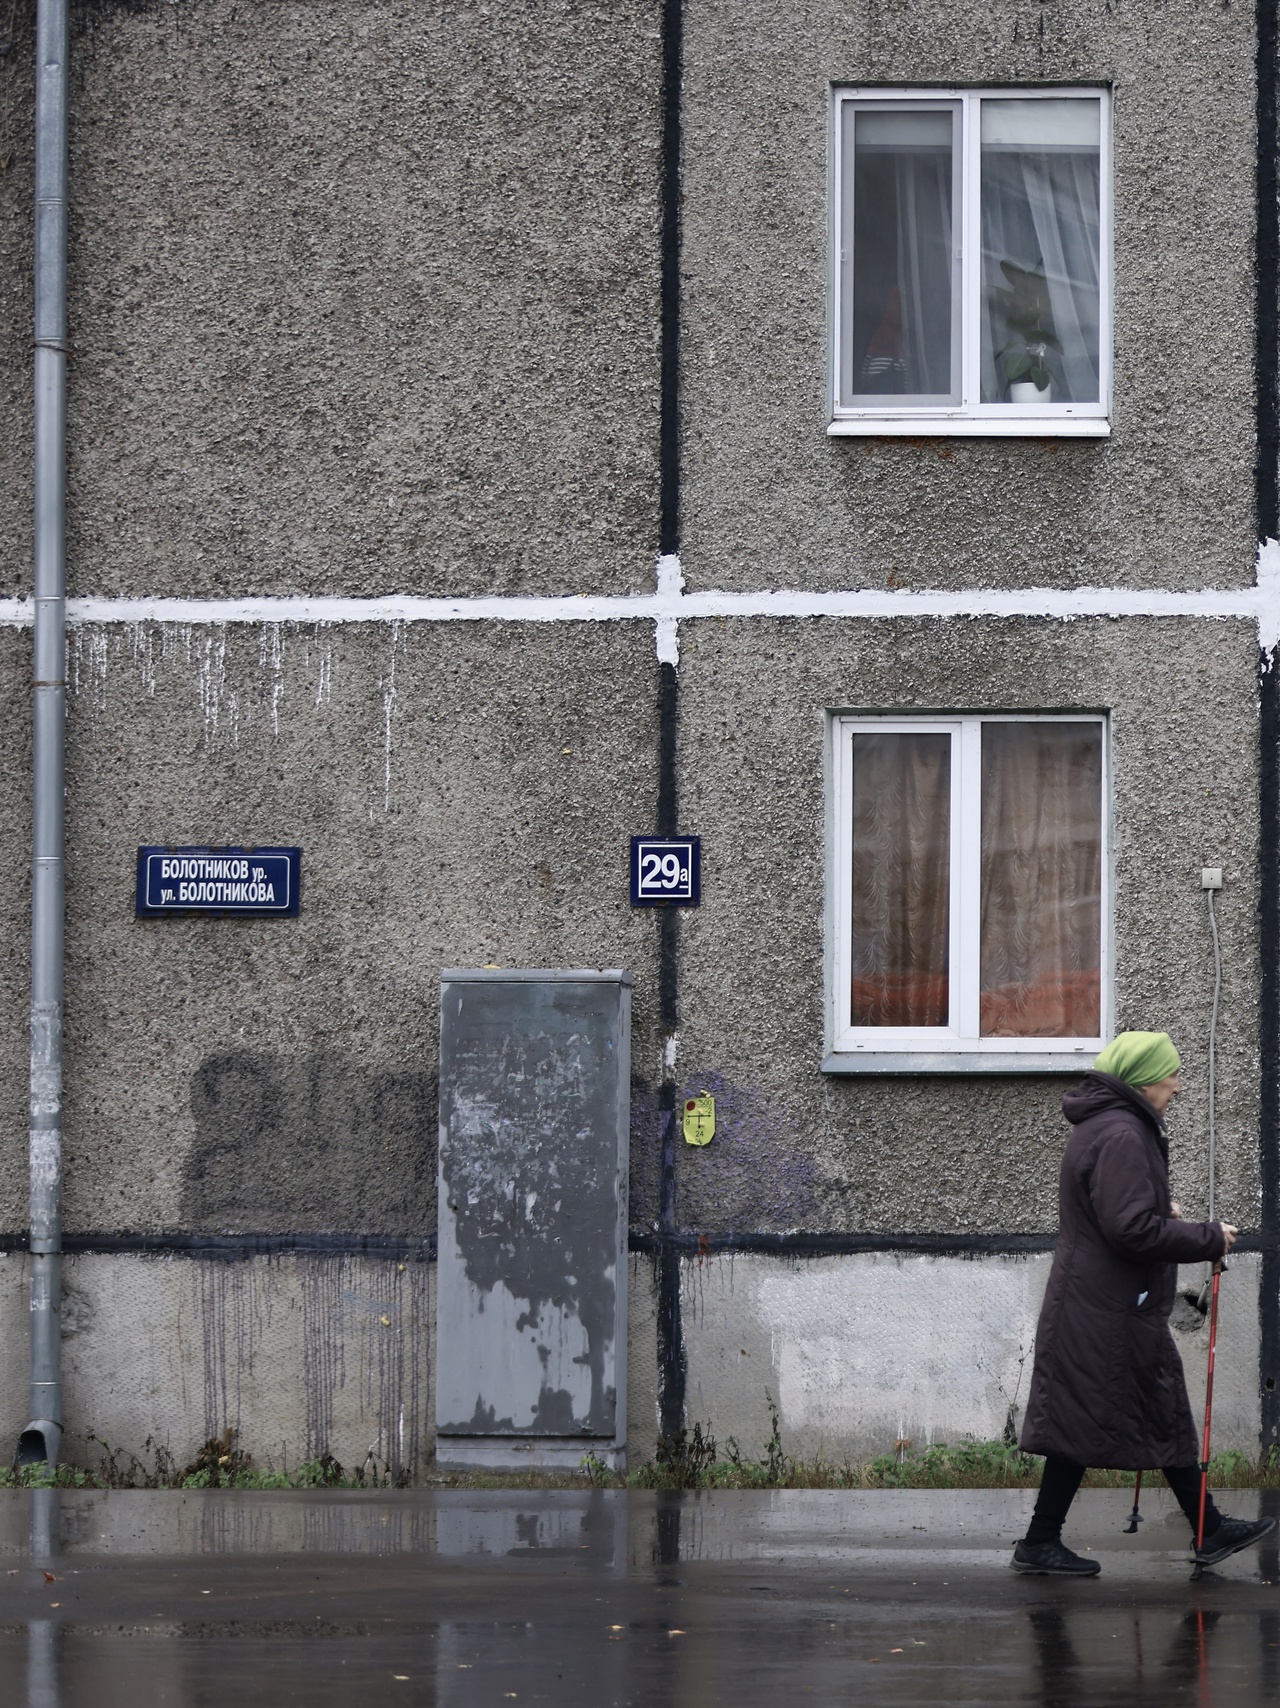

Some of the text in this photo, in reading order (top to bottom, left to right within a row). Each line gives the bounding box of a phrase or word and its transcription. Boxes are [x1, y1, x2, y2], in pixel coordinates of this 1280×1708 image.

[161, 859, 268, 883] БОЛОТНИКОВ ур.
[160, 882, 275, 904] ул. БОЛОТНИКОВА
